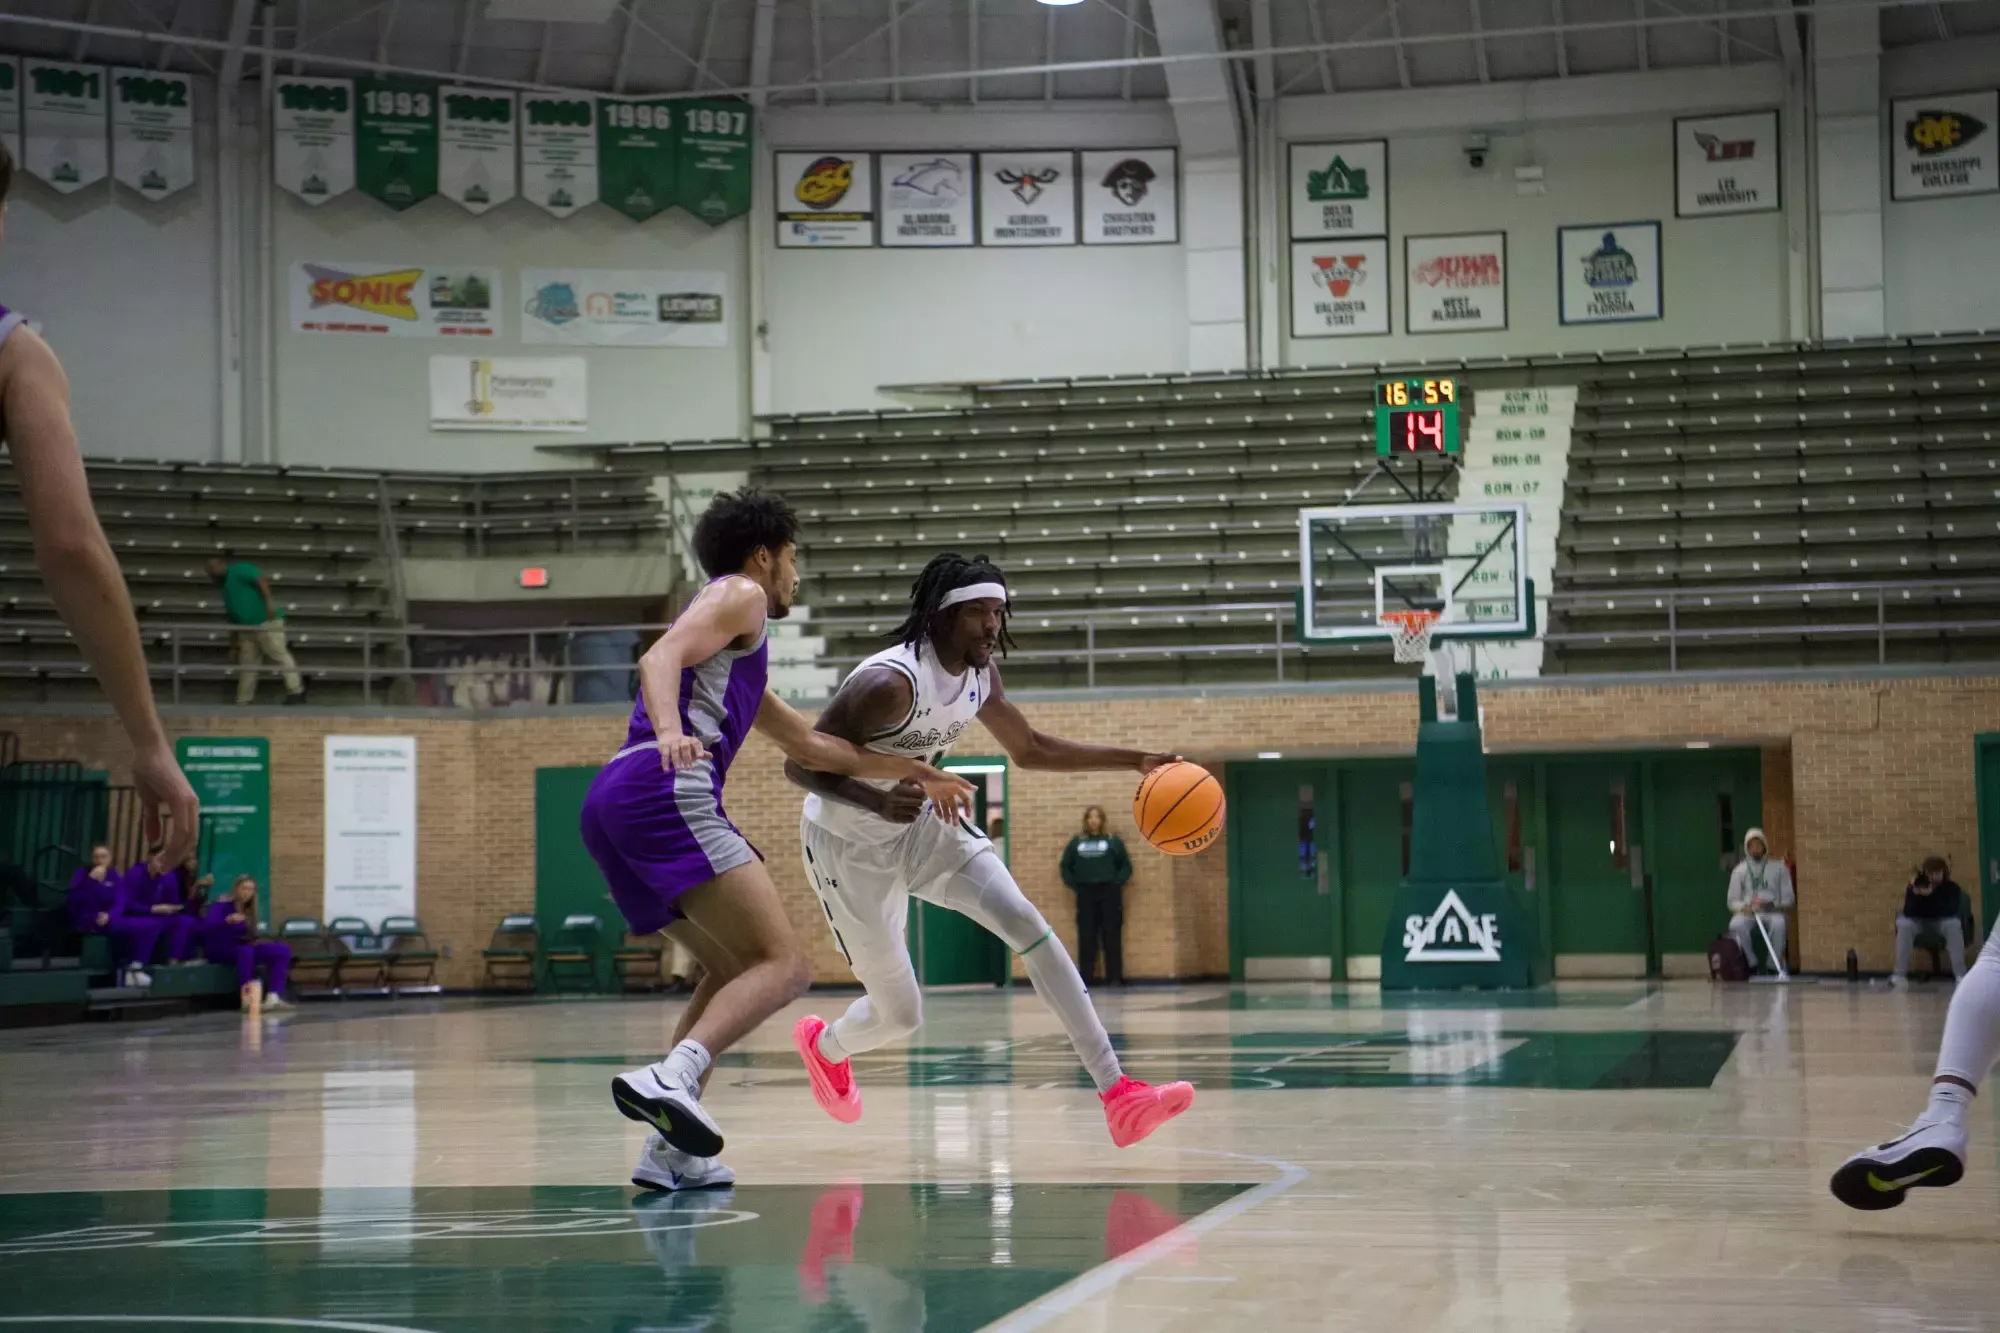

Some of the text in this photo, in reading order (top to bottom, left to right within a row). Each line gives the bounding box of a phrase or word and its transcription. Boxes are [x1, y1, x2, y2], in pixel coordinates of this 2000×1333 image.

[363, 89, 430, 117] 1993
[605, 104, 671, 129] 1996
[685, 109, 746, 135] 1997
[1696, 189, 1758, 205] UNIVERSITY
[1717, 177, 1737, 192] LEE
[315, 279, 415, 306] SONIC
[1593, 291, 1626, 305] WEST
[1407, 410, 1443, 452] 14
